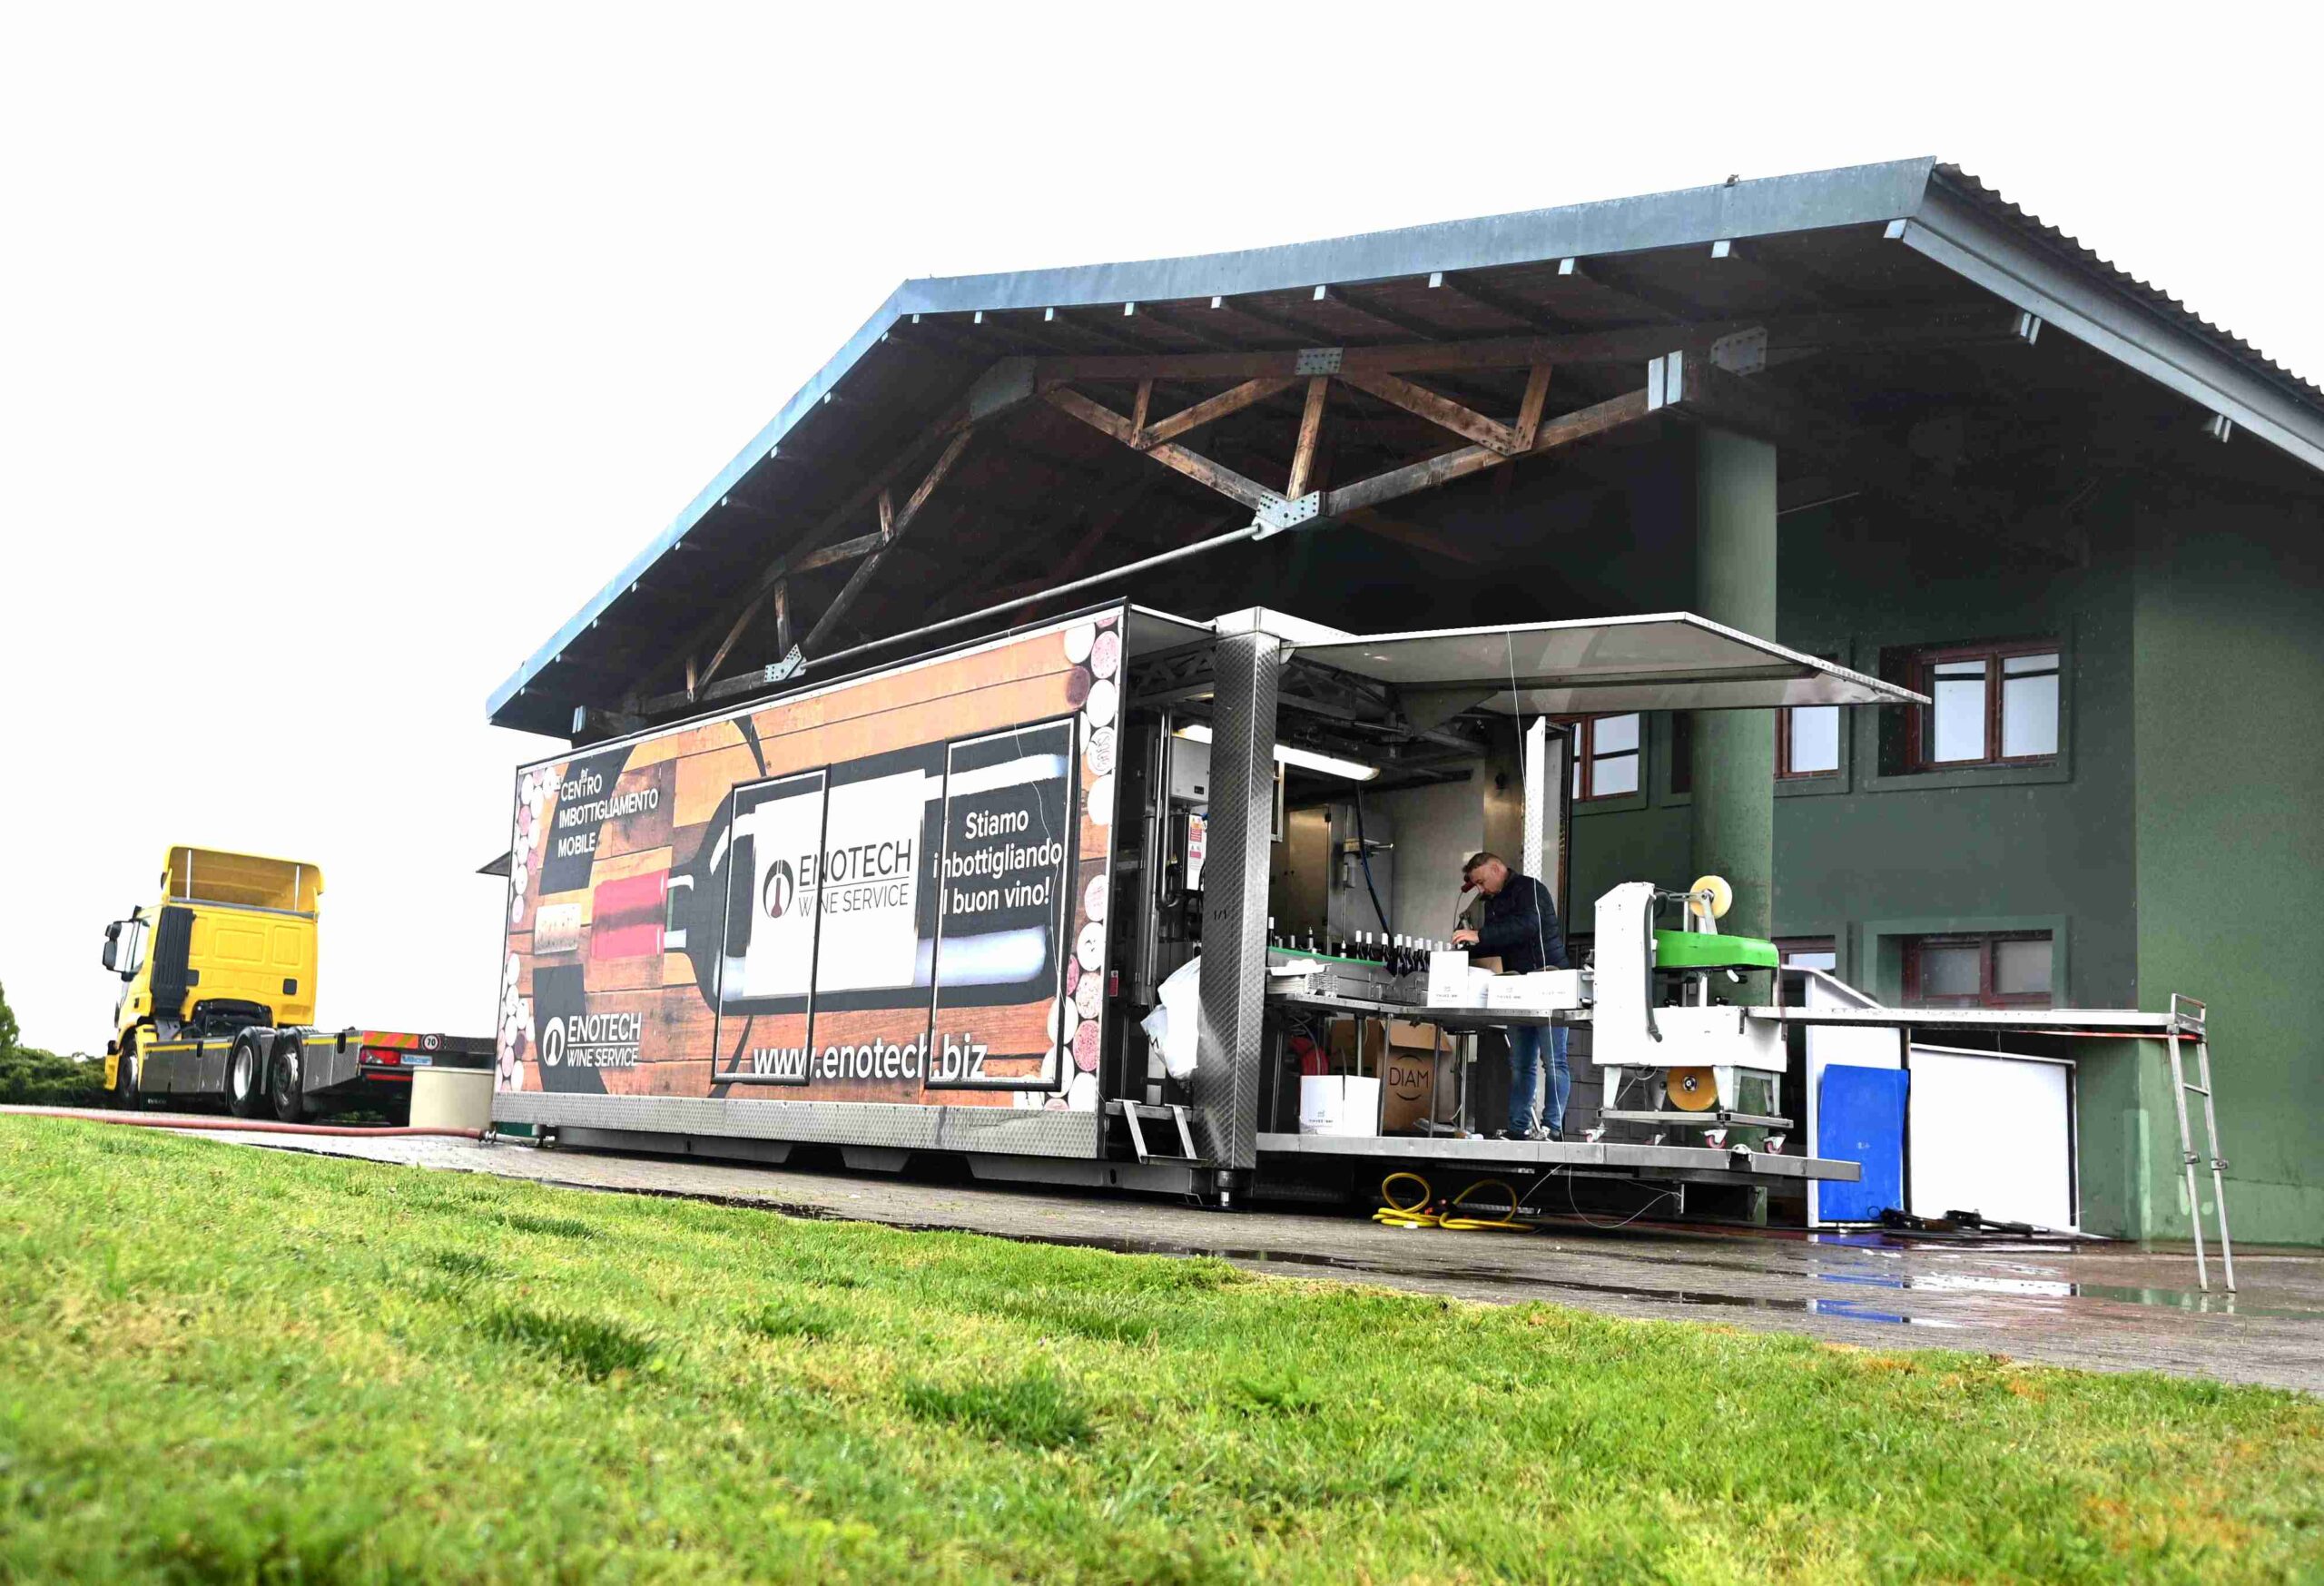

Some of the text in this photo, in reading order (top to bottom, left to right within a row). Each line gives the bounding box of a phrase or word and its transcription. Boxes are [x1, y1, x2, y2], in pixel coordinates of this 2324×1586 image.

[560, 773, 603, 802] CENTRO
[559, 788, 659, 829] IMBOTTIGLIAMENTO
[965, 809, 1029, 839] Stiamo
[557, 832, 596, 858] MOBILE
[799, 838, 911, 887] ENOTECH
[799, 882, 910, 918] WNE SERVICE
[952, 887, 1000, 914] buon
[1004, 876, 1050, 909] vino!
[567, 1011, 642, 1042] ENOTECH
[427, 1038, 437, 1047] 70
[566, 1047, 639, 1068] WINE SERVICE
[1389, 1067, 1429, 1089] DIAM
